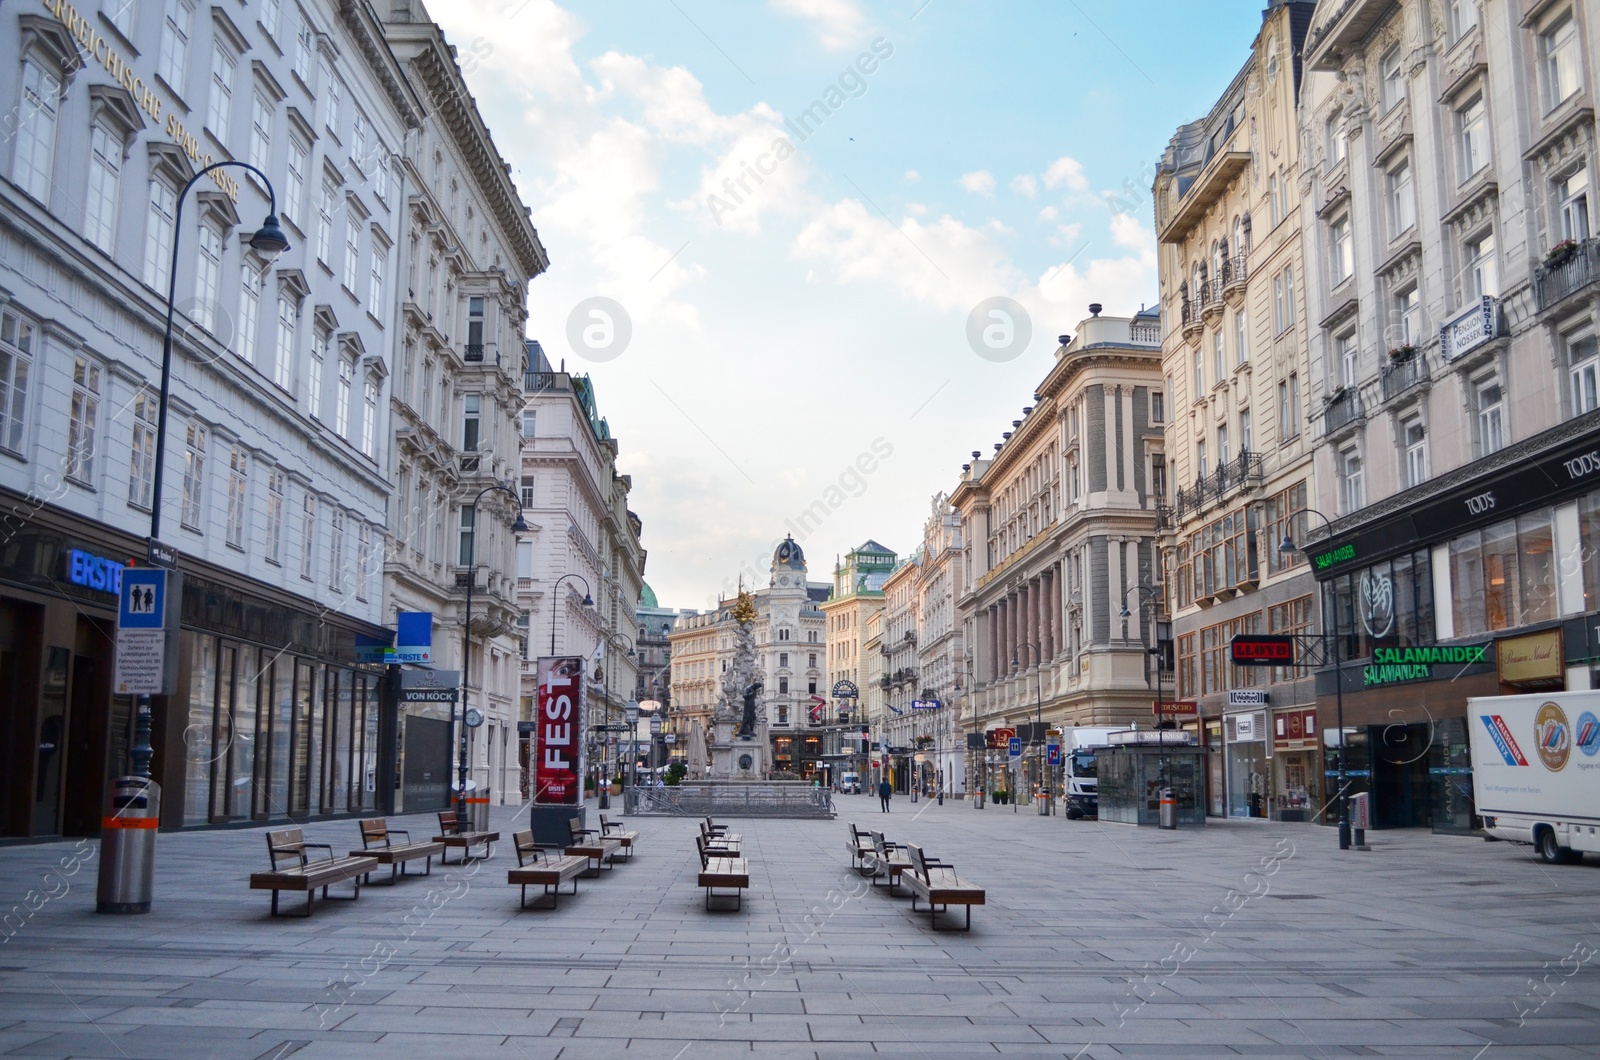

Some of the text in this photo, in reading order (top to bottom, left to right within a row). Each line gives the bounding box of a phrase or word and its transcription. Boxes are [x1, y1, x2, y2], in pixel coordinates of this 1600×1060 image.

[1453, 315, 1482, 339] PENSION
[1482, 295, 1493, 336] PENSION
[1440, 330, 1448, 360] NOSSEK
[1456, 327, 1482, 350] NOSSEK
[71, 548, 125, 597] ERSTE
[1236, 644, 1287, 656] LLOYD
[1374, 646, 1485, 663] SALAMANDER
[1363, 664, 1429, 685] SALAMANDER
[406, 690, 453, 700] VON KÖCK
[545, 670, 572, 769] FEST
[1442, 732, 1453, 820] SALAMNDER
